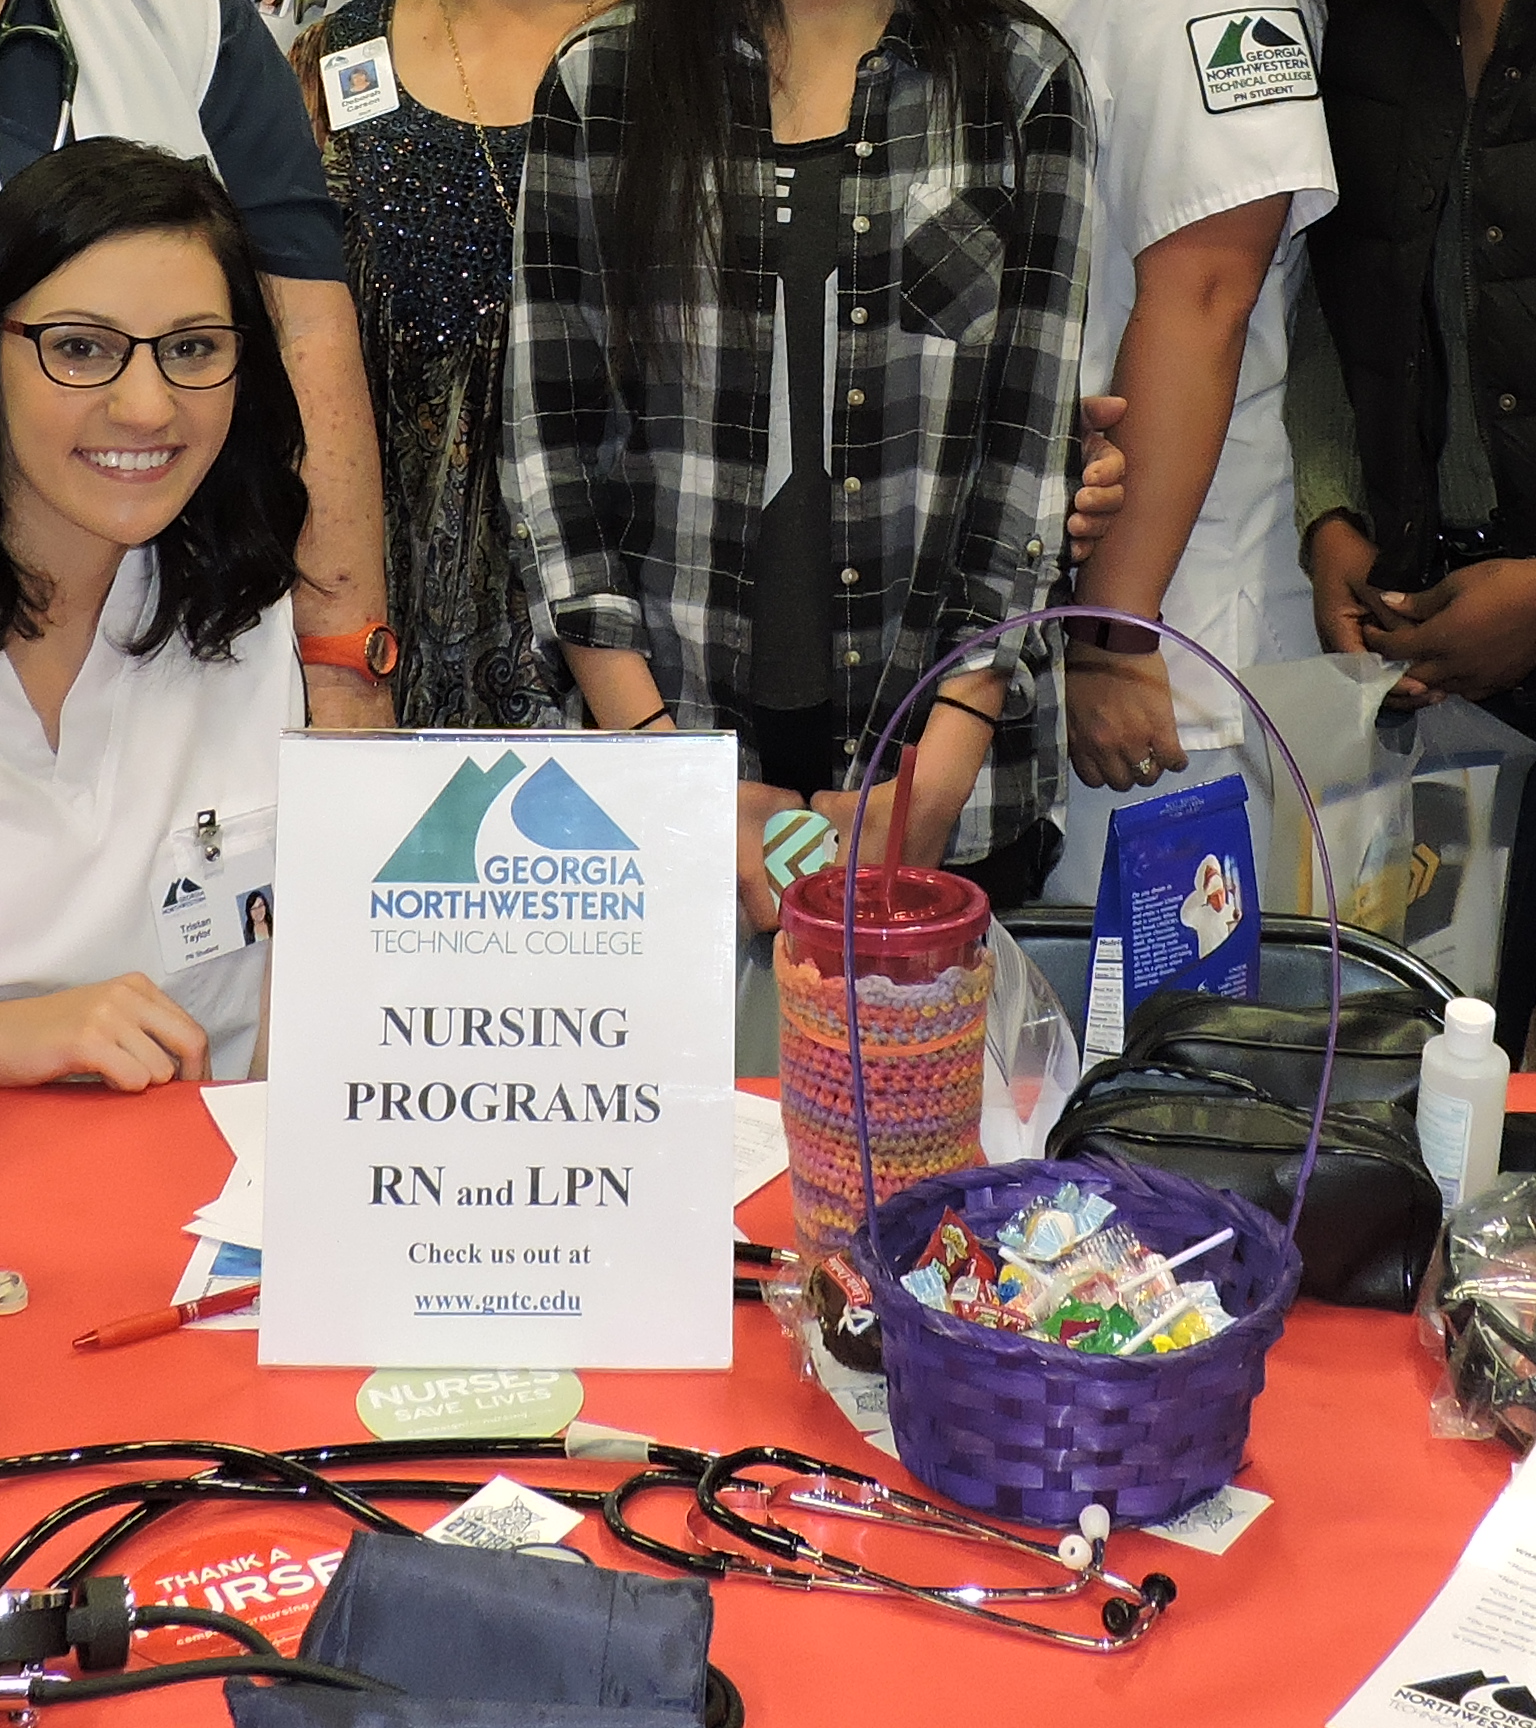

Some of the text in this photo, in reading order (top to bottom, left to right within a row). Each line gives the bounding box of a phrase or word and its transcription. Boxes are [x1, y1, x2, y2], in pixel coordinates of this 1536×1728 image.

[1206, 59, 1309, 82] NORTHWESTERN
[1246, 49, 1306, 62] GEORGIA
[1208, 71, 1312, 94] TECHNICAL COLLEGE
[1234, 85, 1294, 102] PN STUDENT
[484, 855, 645, 886] GEORGIA
[371, 890, 644, 921] NORTHWESTERN
[371, 929, 643, 955] TECHNICAL COLLEGE
[379, 1007, 629, 1048] NURSING
[344, 1081, 661, 1124] PROGRAMS
[368, 1165, 633, 1207] RN and LPN
[408, 1242, 591, 1266] Check us out at
[414, 1291, 582, 1315] www.gntc.edu
[368, 1369, 559, 1409] NURSES
[395, 1388, 551, 1422] SAVE LIVES
[155, 1547, 292, 1593] THANK A
